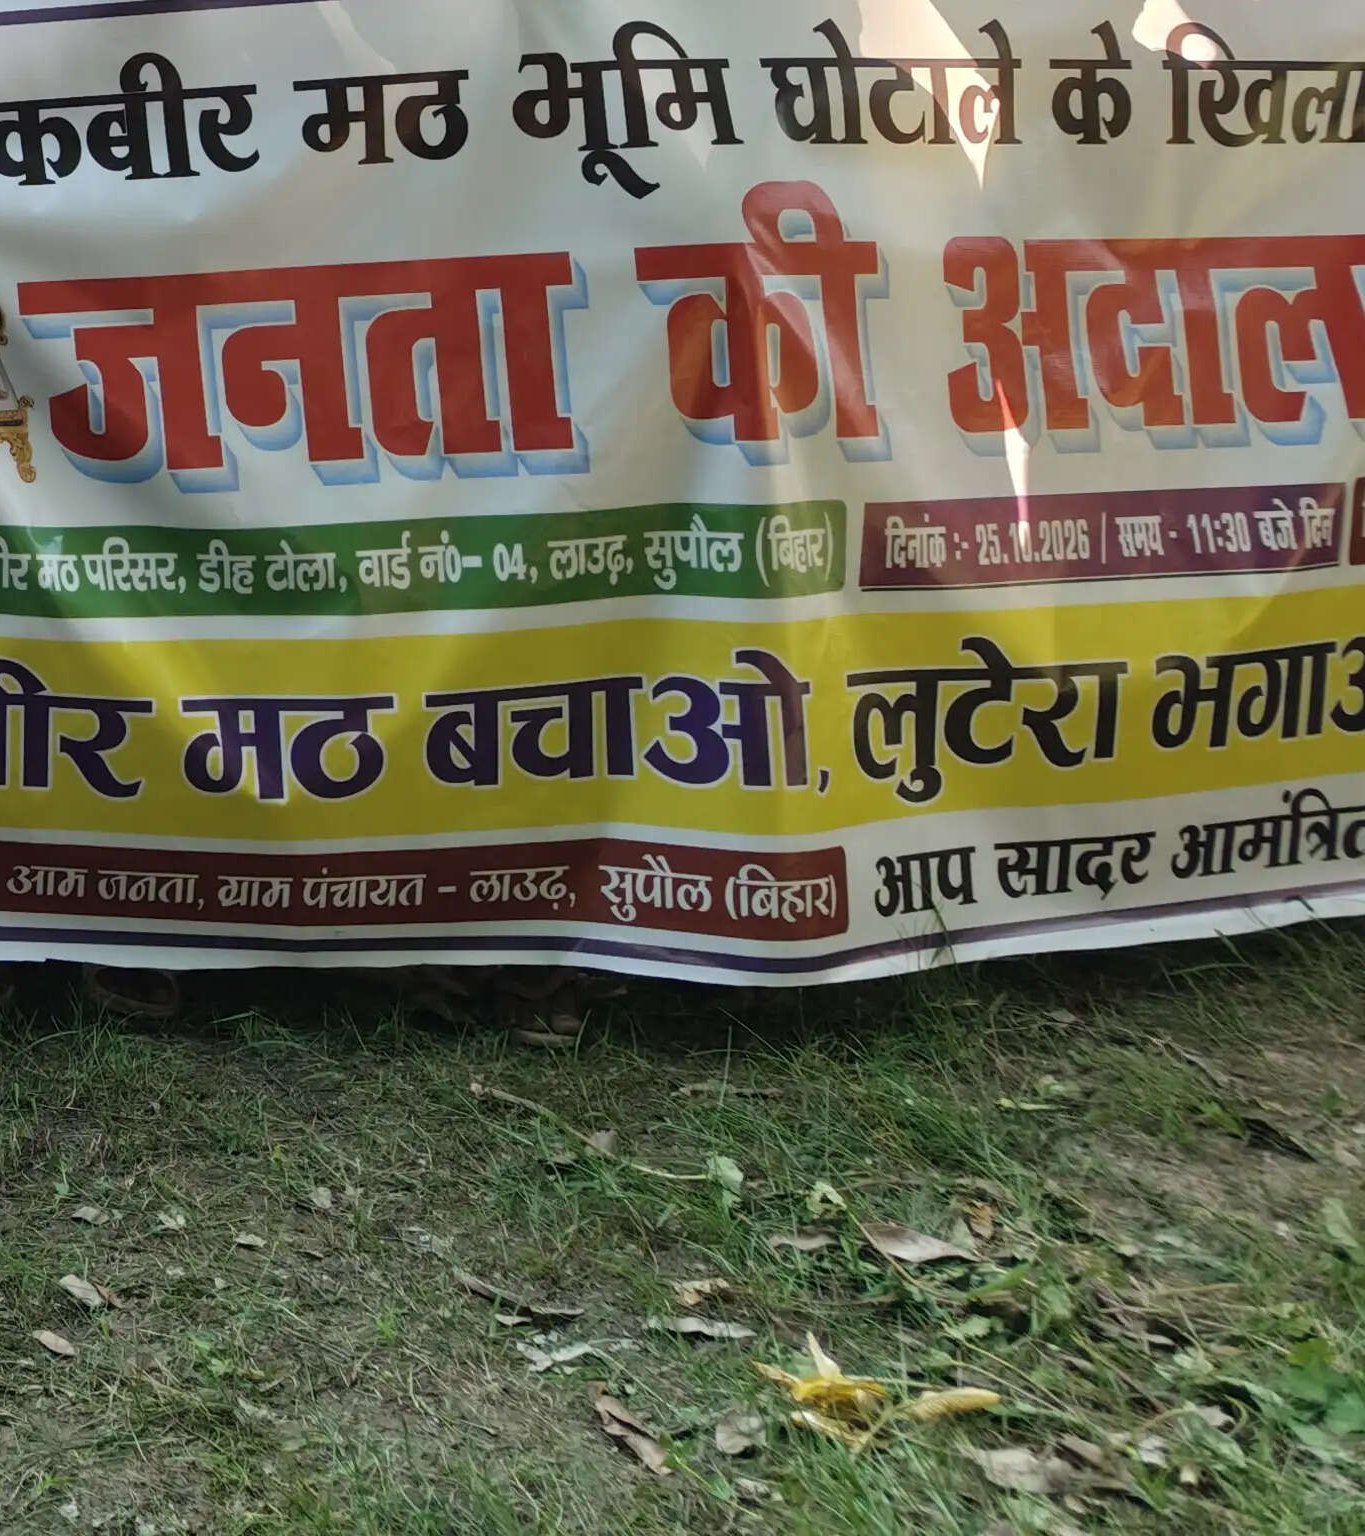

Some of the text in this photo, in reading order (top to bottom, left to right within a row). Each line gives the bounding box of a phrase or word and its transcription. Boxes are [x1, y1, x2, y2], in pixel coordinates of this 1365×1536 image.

[293, 68, 470, 165] मठ
[512, 20, 742, 199] भूमि
[759, 18, 1022, 146] घोटाले
[1050, 21, 1132, 145] के
[1162, 20, 1365, 148] खिला
[18, 180, 1365, 479] जनता की अदाल
[36, 552, 84, 593] मठ
[85, 537, 187, 595] परिसर,
[197, 539, 256, 594] डीह
[267, 540, 347, 594] टोला,
[356, 530, 411, 591] वार्ड
[644, 514, 745, 590] सुपौल
[754, 512, 833, 588] (बिहार)
[884, 496, 1336, 568] दिनांक 25.10.2026 समय 11:30 बजे दिन
[180, 694, 398, 803] मठ
[423, 648, 831, 796] बचाओ,
[846, 636, 1128, 804] लुटेरा
[6, 864, 87, 898] आम
[96, 867, 205, 911] जनता,
[216, 871, 293, 908] ग्राम
[302, 867, 427, 910] पंचायत
[599, 845, 714, 922] सुपौल
[726, 866, 837, 922] (बिहार)
[872, 844, 978, 918] आप
[997, 830, 1157, 901] सादर
